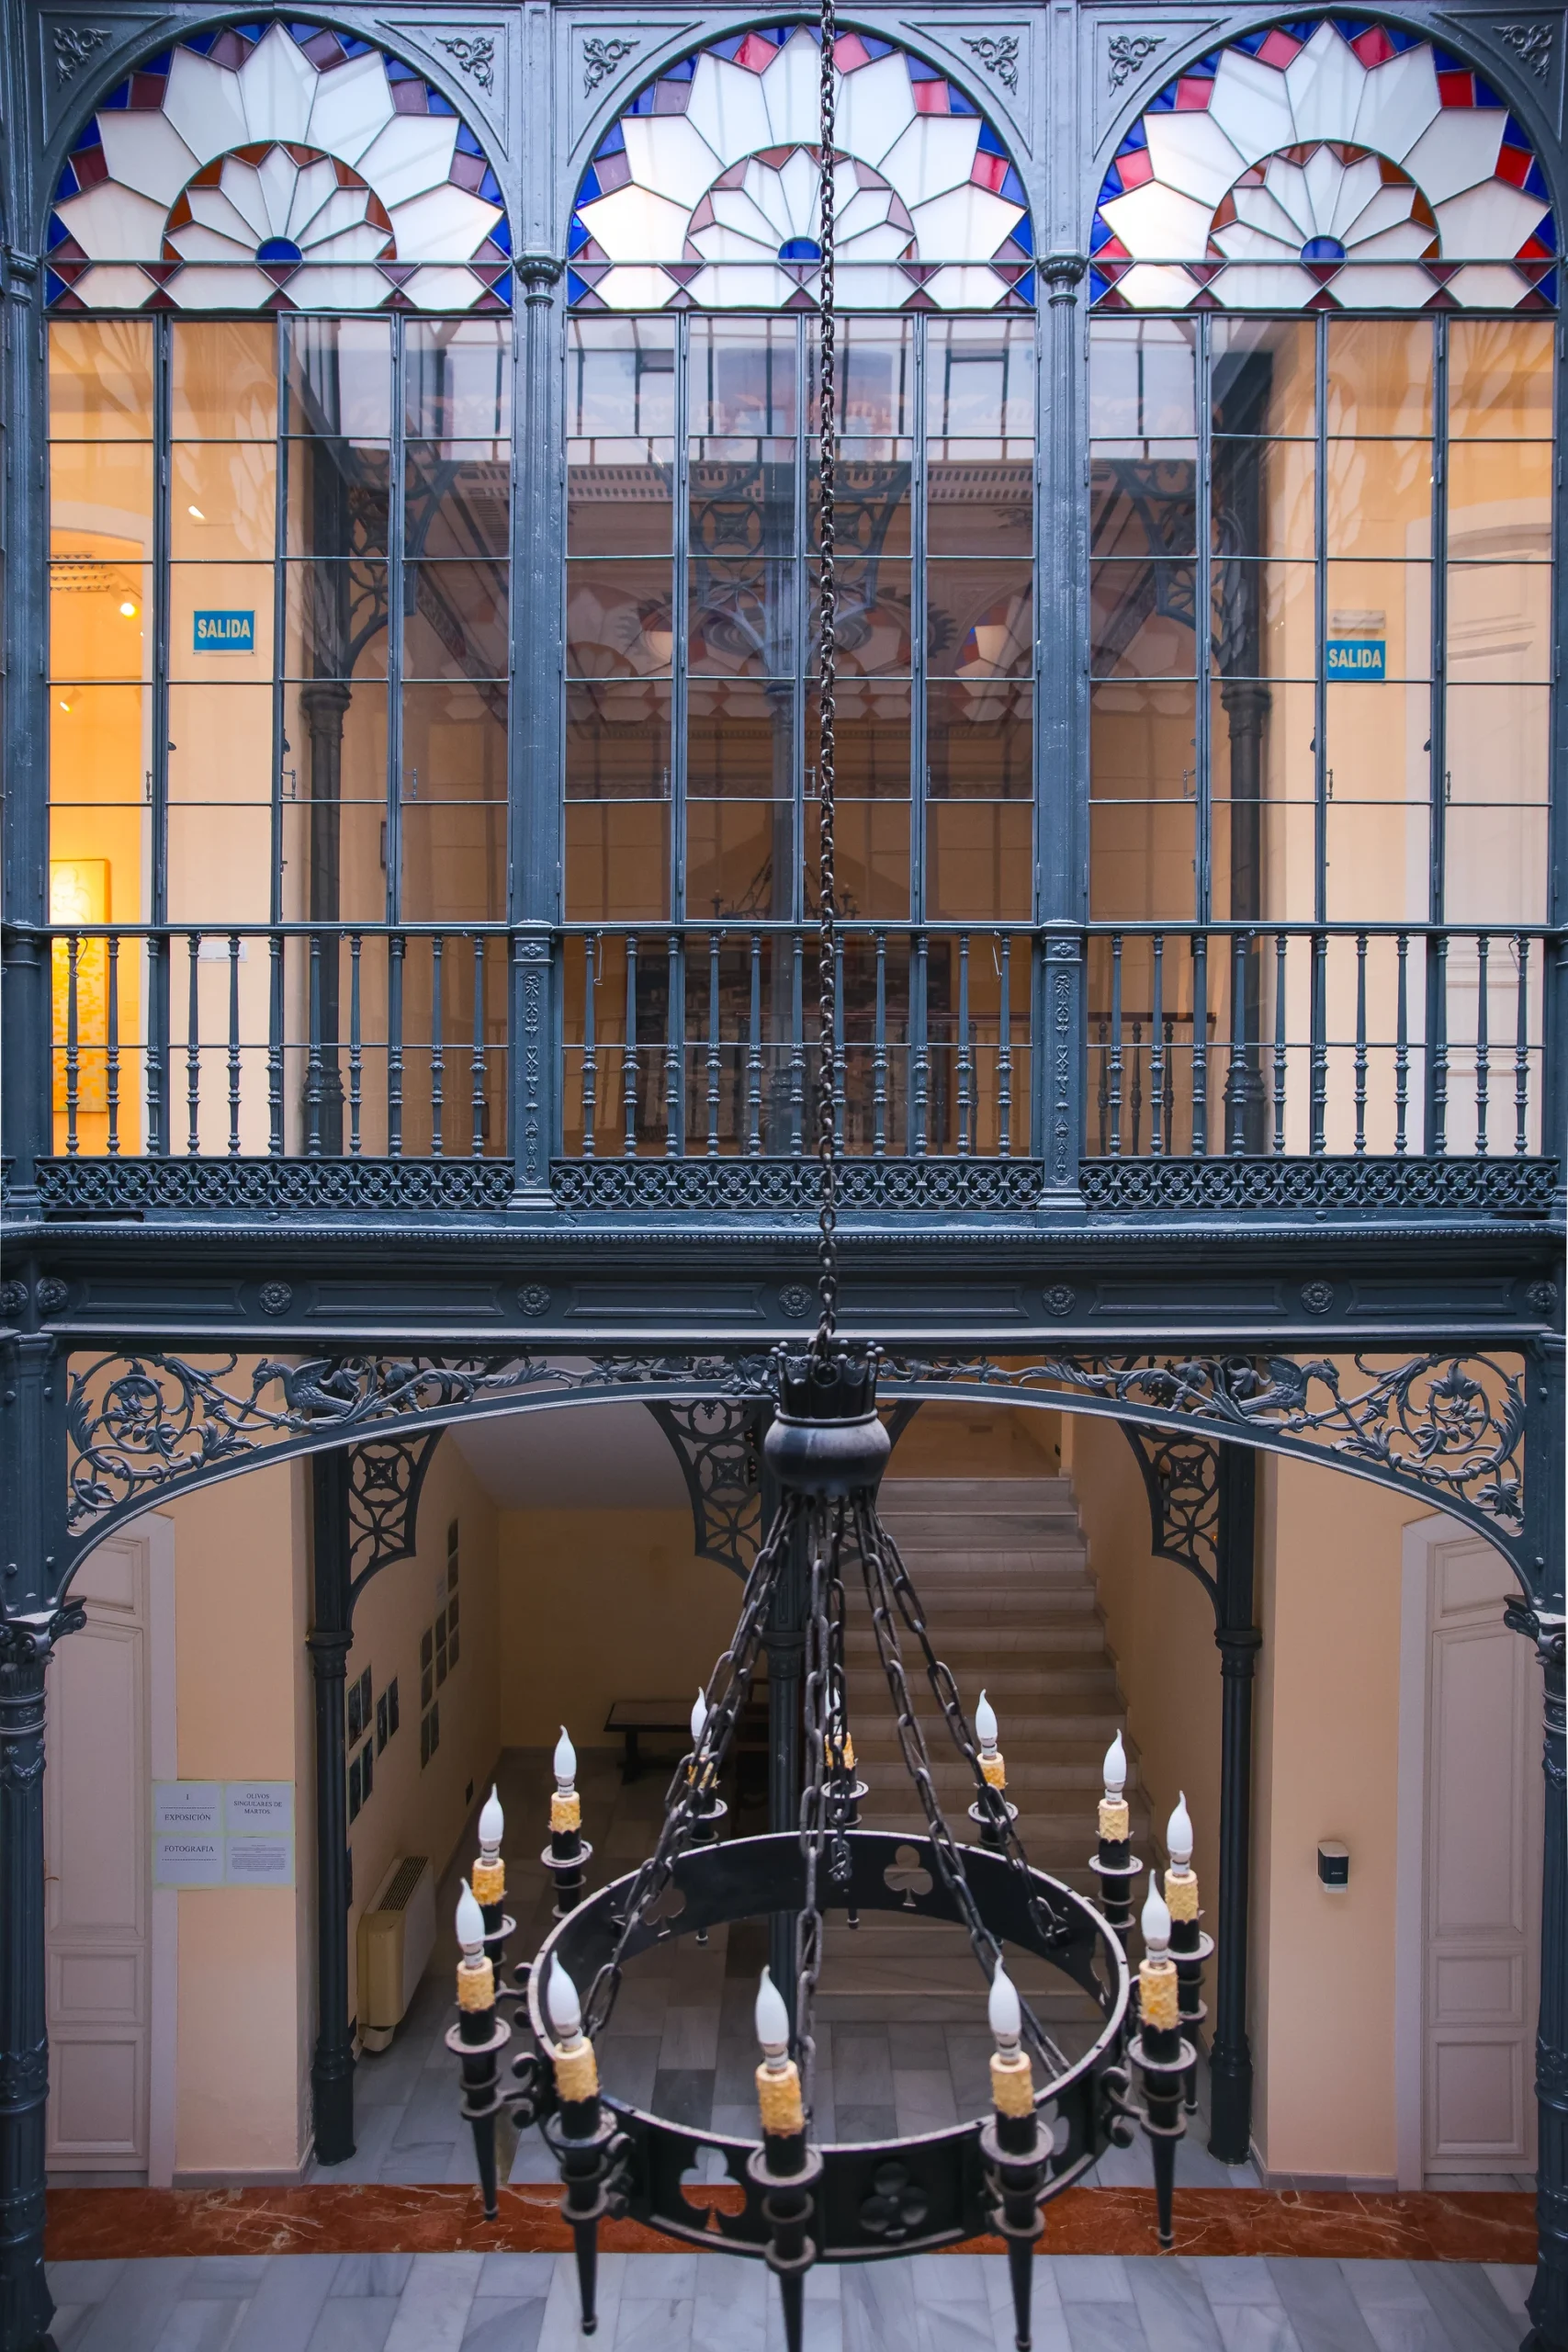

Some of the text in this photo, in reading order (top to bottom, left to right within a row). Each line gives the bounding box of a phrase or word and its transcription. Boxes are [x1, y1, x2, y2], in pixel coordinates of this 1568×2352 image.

[197, 618, 251, 639] SALIDA
[1328, 648, 1382, 668] SALIDA
[164, 1813, 211, 1821] EXPOSICIÓN
